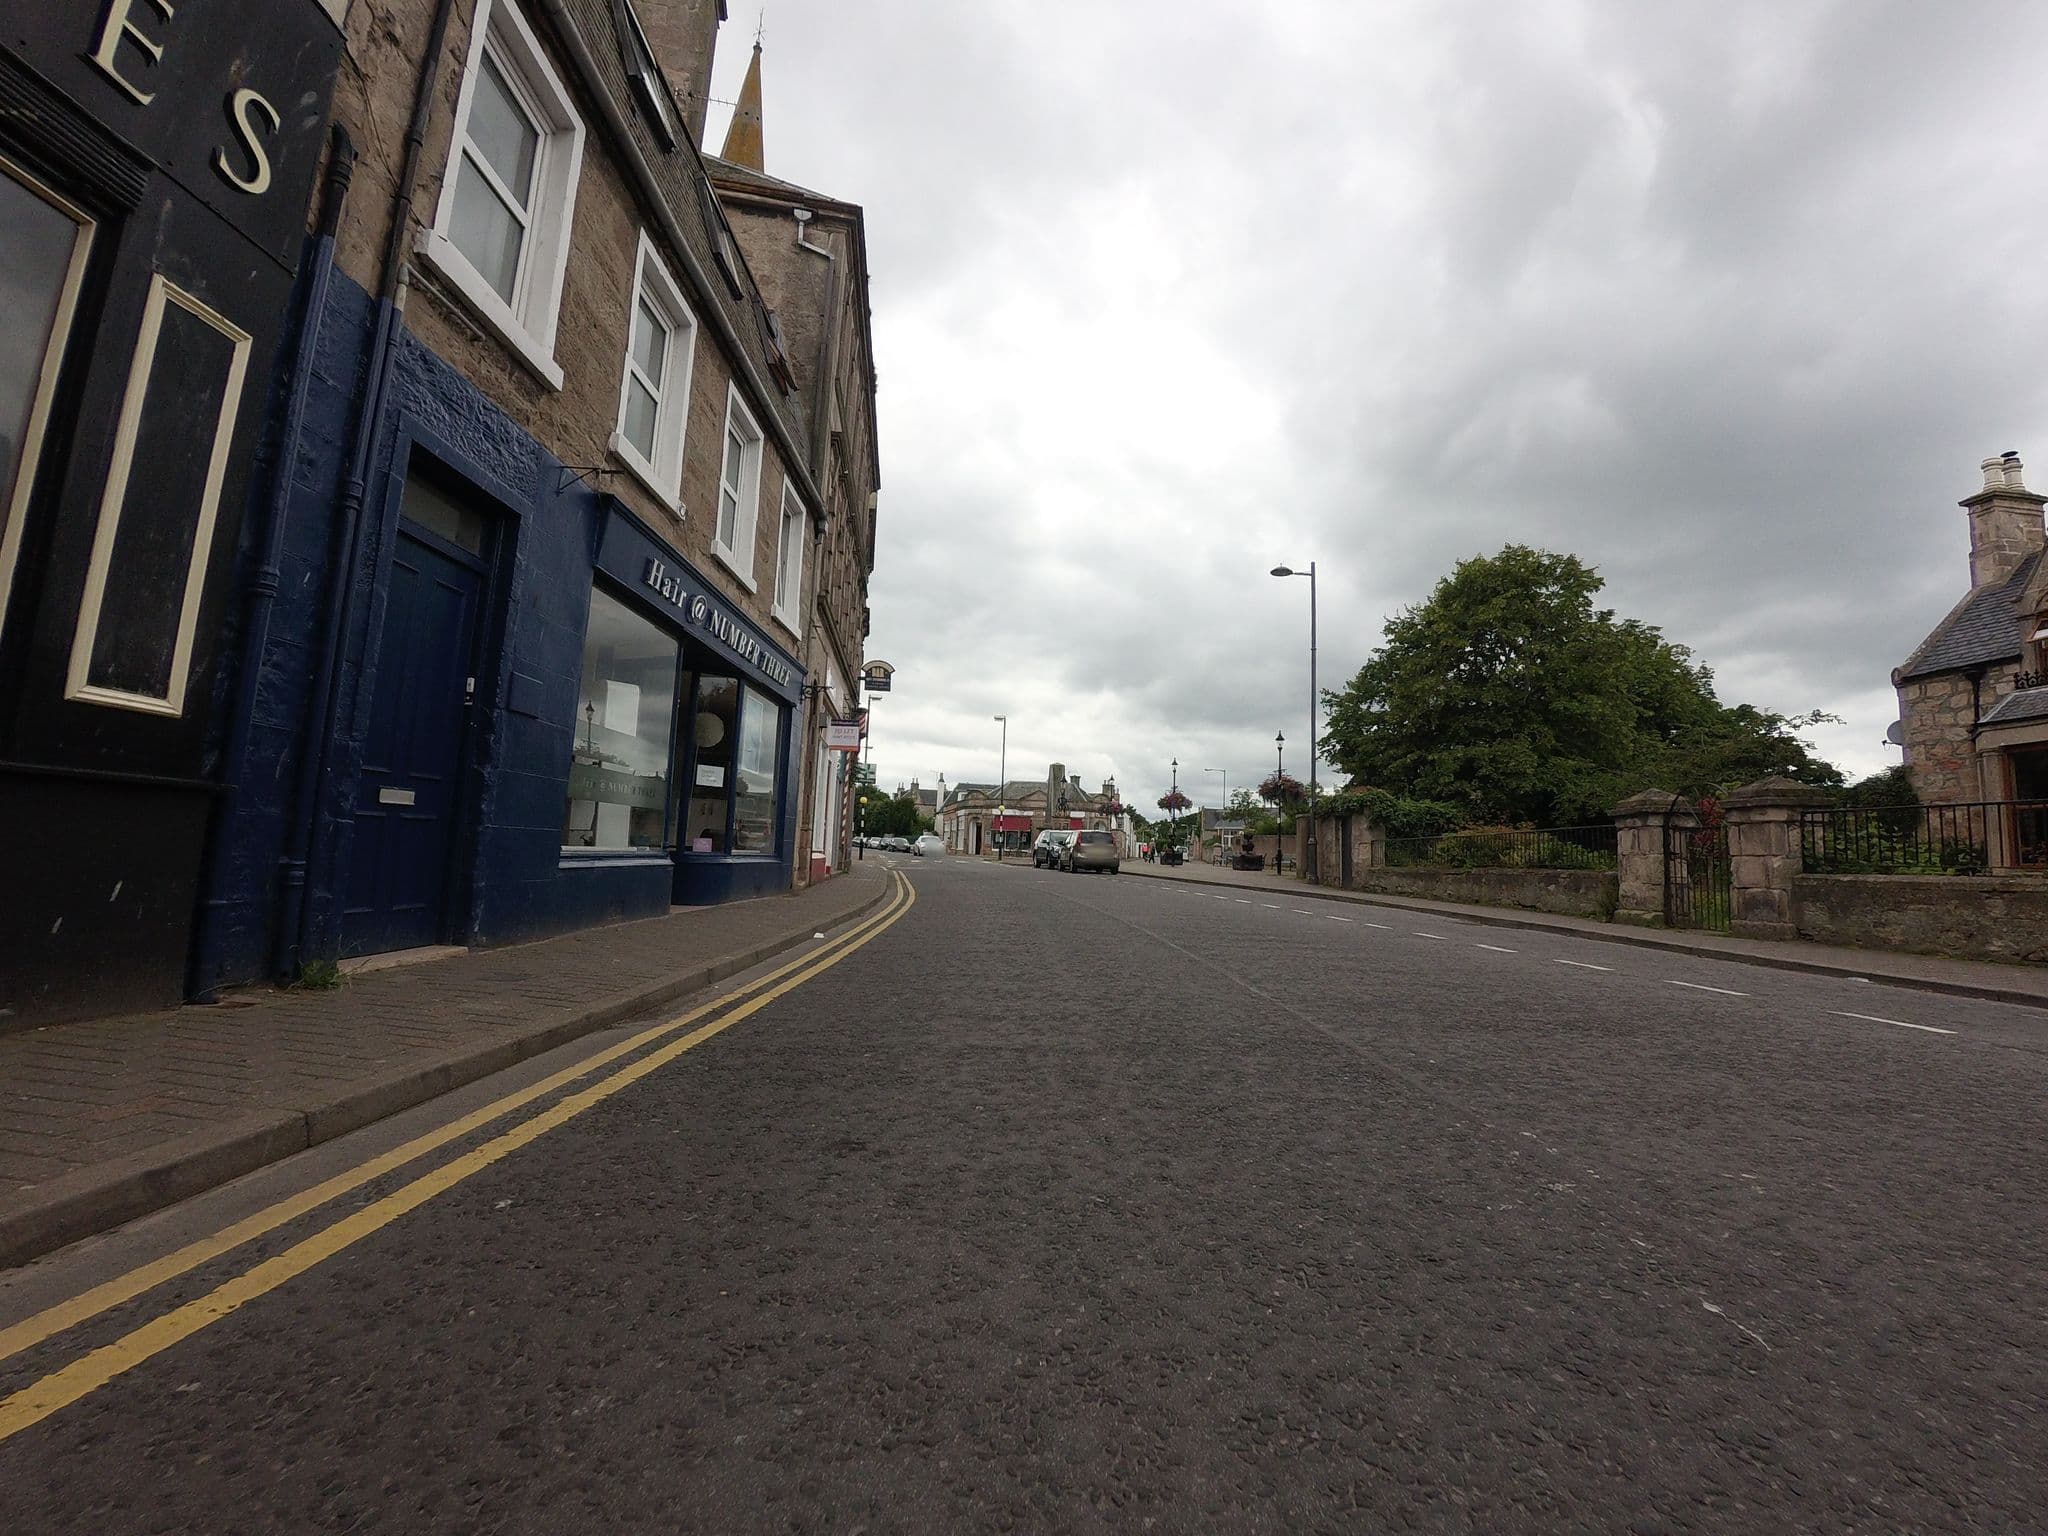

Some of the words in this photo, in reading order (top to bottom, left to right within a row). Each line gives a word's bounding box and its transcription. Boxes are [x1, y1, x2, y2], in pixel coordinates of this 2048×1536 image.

[647, 557, 687, 607] Hair
[691, 594, 708, 625] @
[709, 609, 761, 666] NUMBER
[761, 651, 792, 687] THREE
